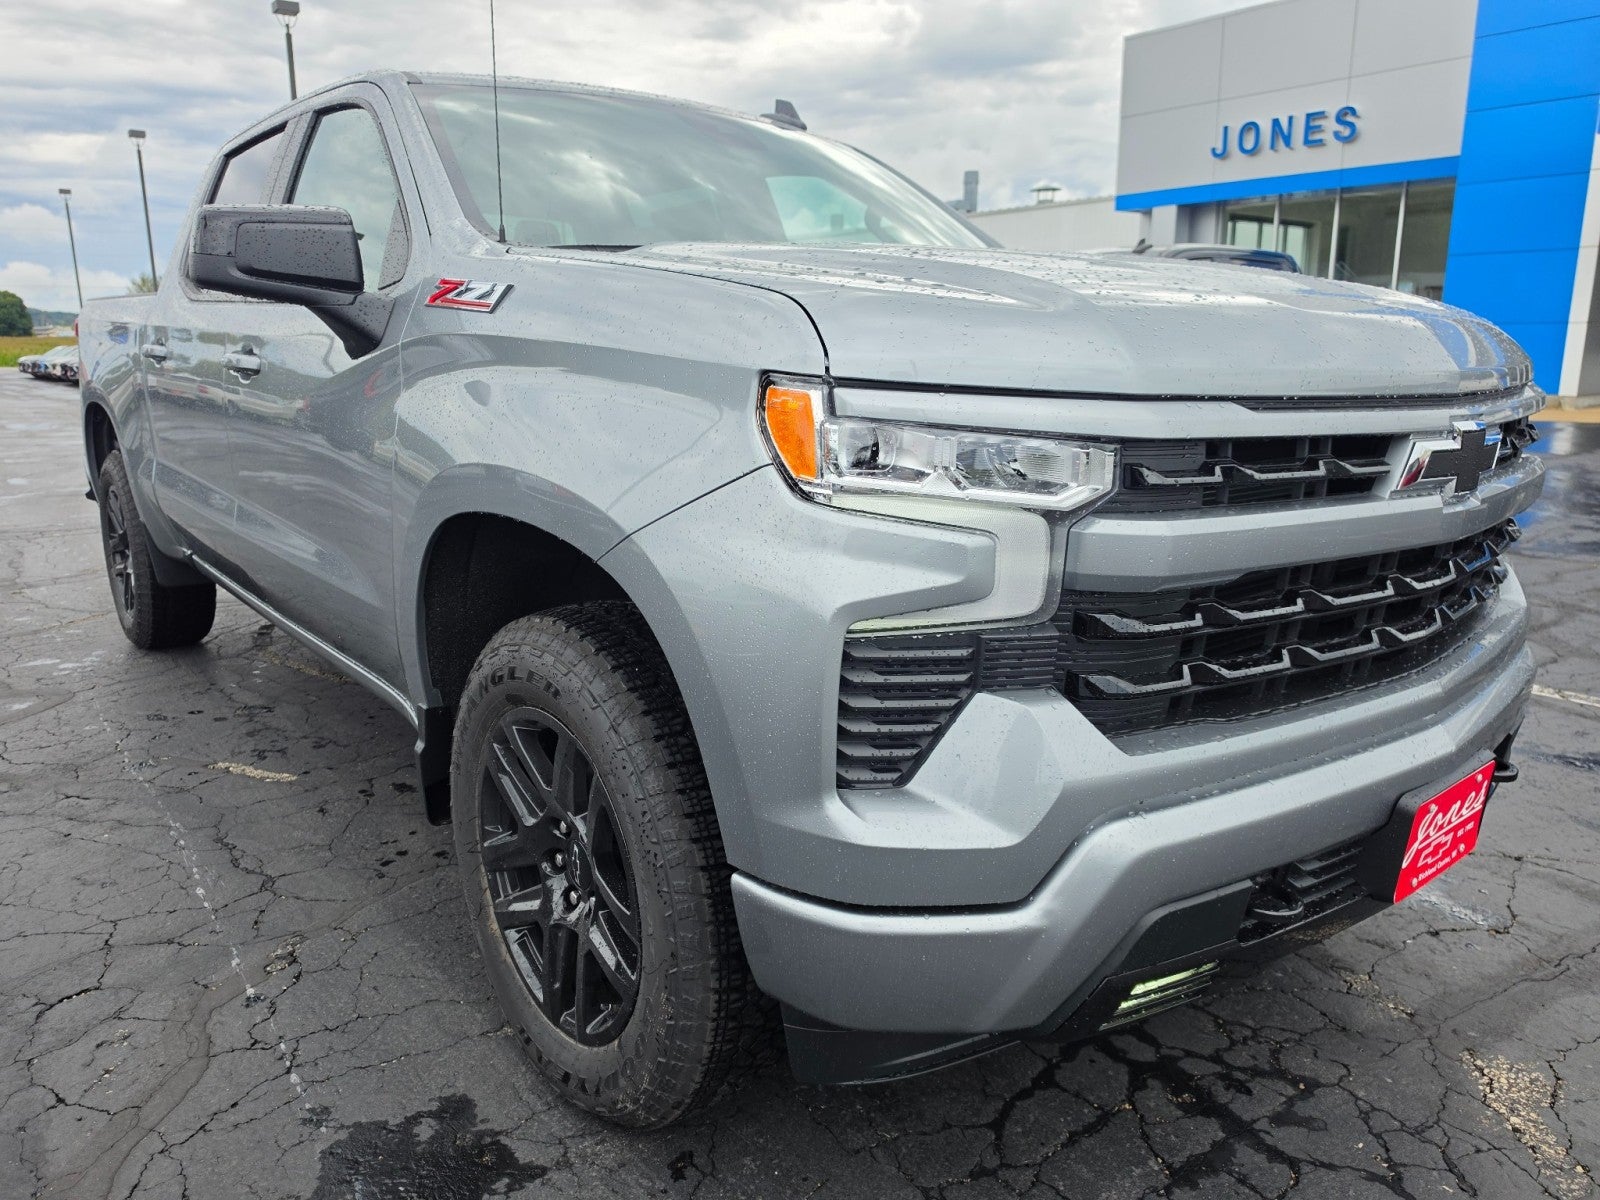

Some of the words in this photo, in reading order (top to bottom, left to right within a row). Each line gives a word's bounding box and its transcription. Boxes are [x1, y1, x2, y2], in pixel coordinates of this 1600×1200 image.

[1211, 106, 1359, 159] JONES
[426, 278, 512, 313] Z71
[1401, 780, 1488, 869] Jones
